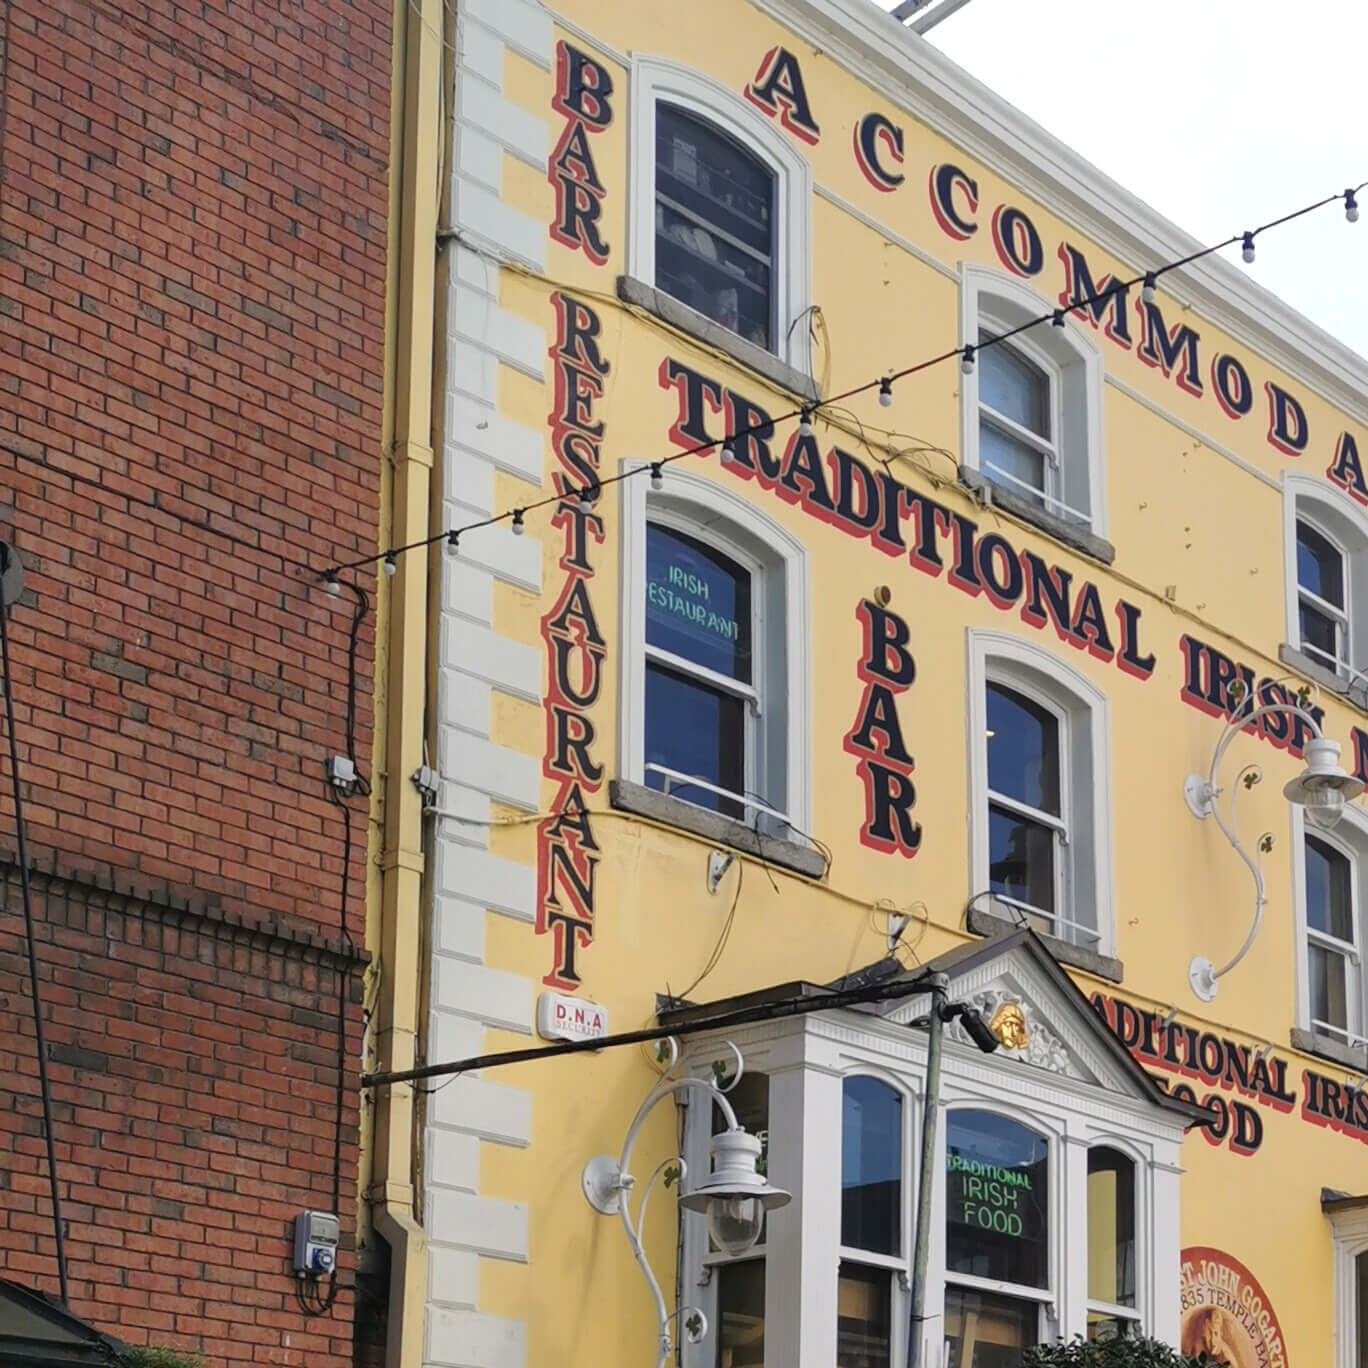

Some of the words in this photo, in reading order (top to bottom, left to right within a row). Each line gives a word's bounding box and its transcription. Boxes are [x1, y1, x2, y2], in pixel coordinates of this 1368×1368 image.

[549, 39, 613, 266] BAR
[658, 356, 1156, 681] TRADITIONAL
[669, 565, 709, 600] IRISH
[647, 582, 739, 641] ESTAURANT
[535, 291, 610, 990] RESTAURANT
[843, 598, 922, 858] BAR
[557, 1003, 601, 1030] D.N.A
[1089, 991, 1296, 1114] ADITIONAL
[946, 1153, 1032, 1190] TRADITIONAL
[963, 1175, 1018, 1210] IRISH
[964, 1201, 1023, 1236] FOOD
[1198, 1259, 1241, 1297] JOHN
[1180, 1288, 1205, 1315] 835
[1207, 1287, 1257, 1340] TEMPLE
